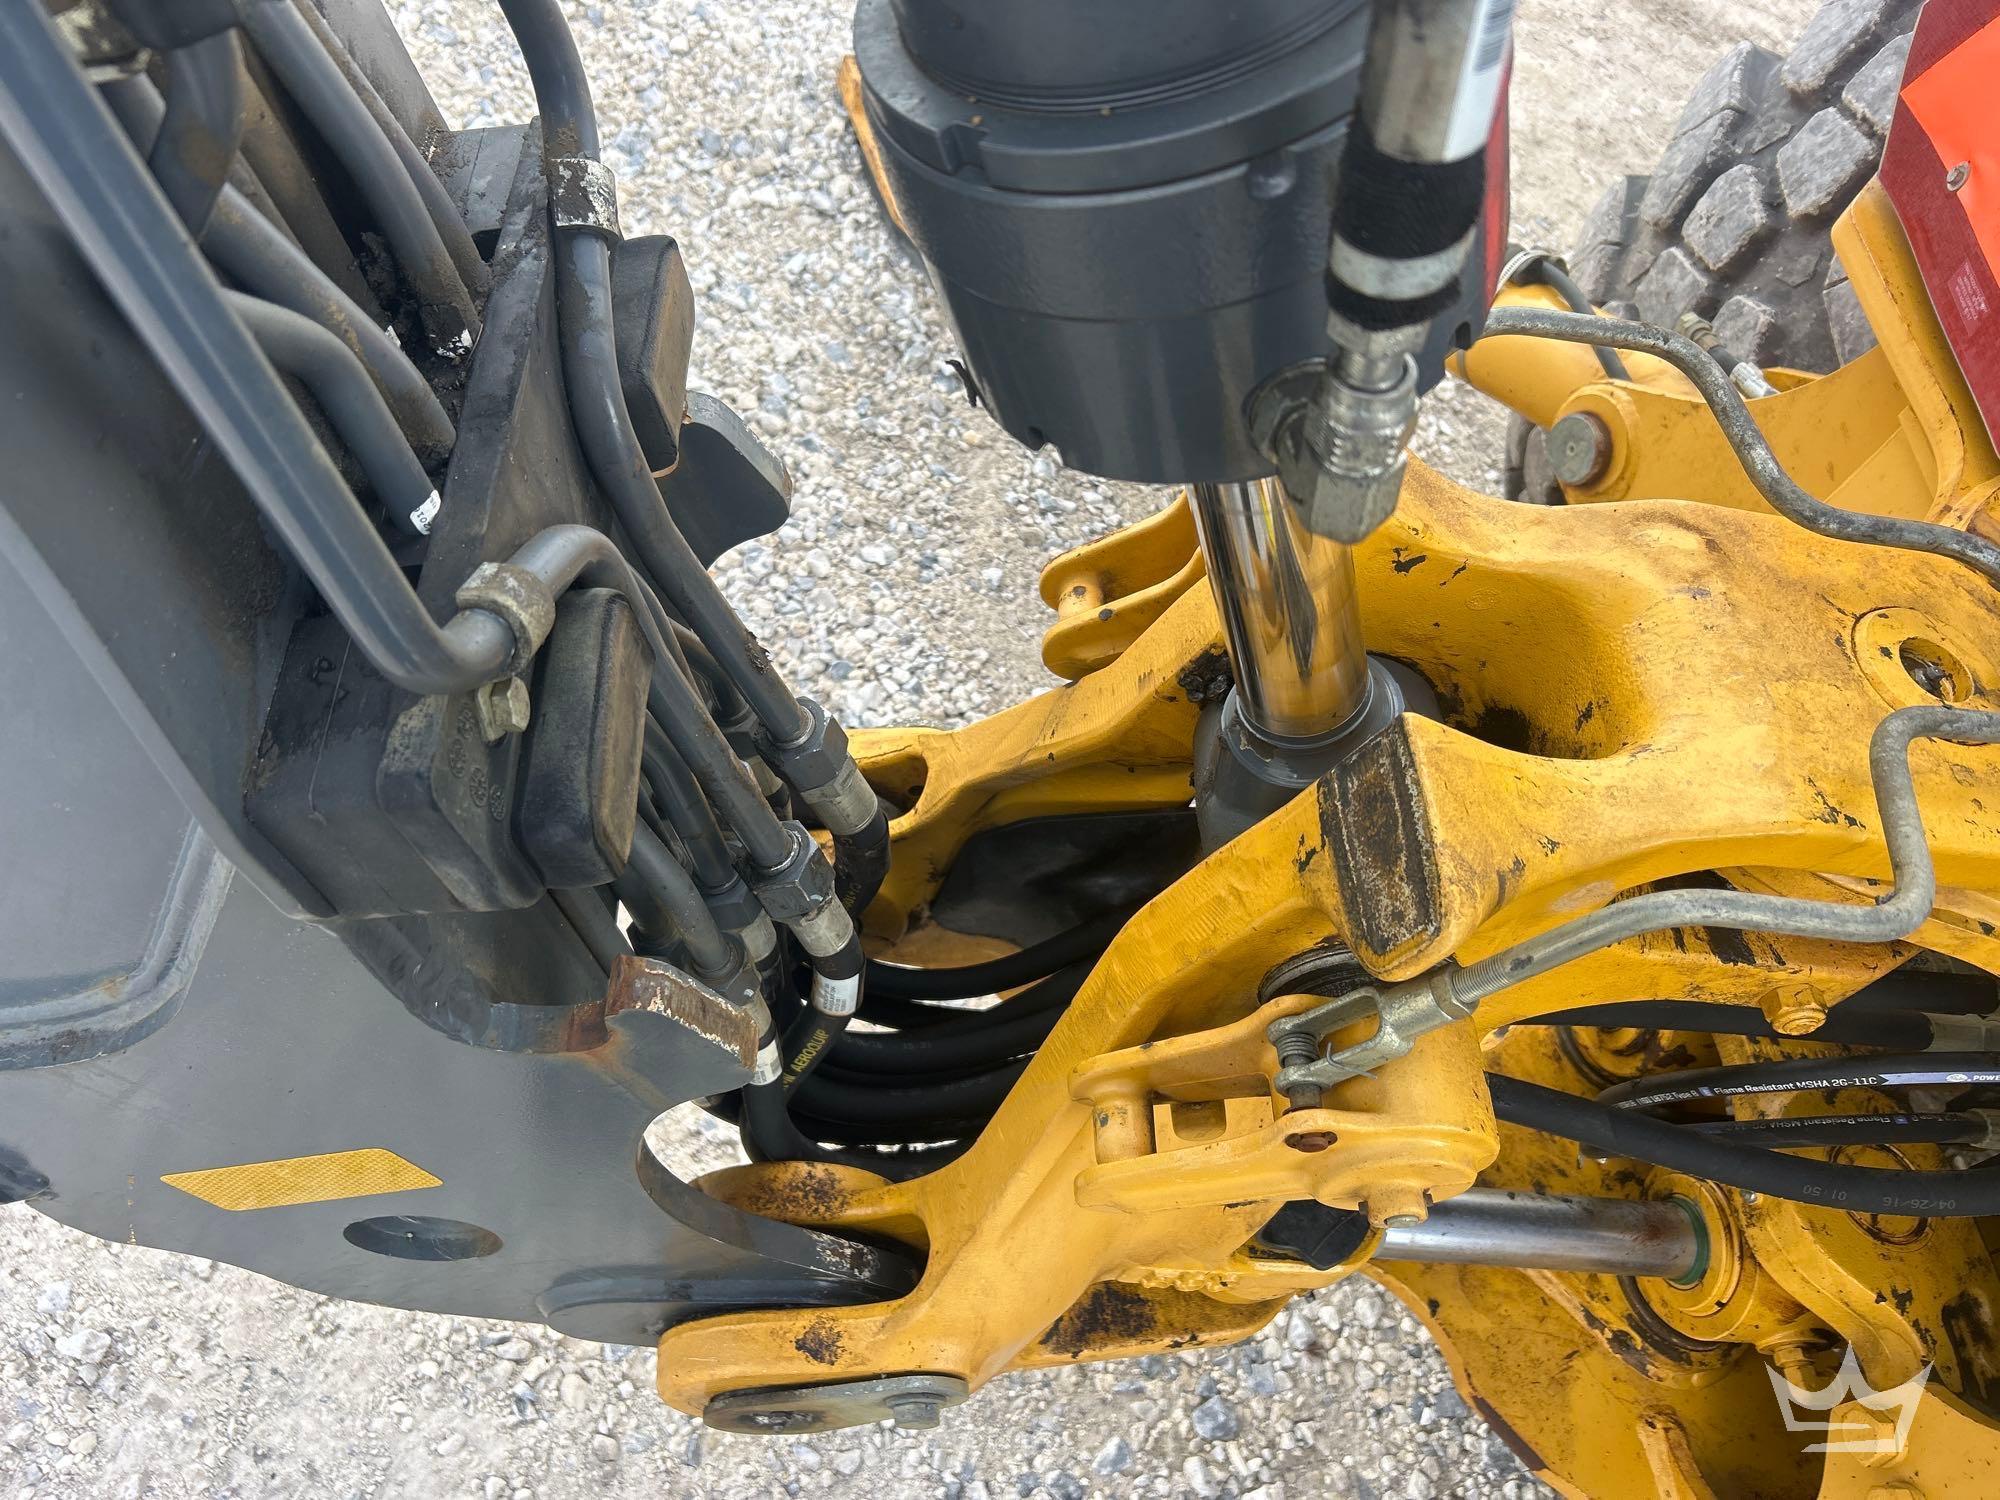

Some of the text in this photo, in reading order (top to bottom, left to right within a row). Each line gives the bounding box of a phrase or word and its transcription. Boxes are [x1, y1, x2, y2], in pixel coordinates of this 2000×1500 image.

[790, 1028, 829, 1072] AEROQUIP
[1713, 1087, 1745, 1095] Flame
[1745, 1083, 1795, 1092] Resistant
[1796, 1079, 1829, 1089] MSHA
[1831, 1076, 1877, 1087] 2G-11C
[1882, 1196, 1956, 1210] 04/26/16
